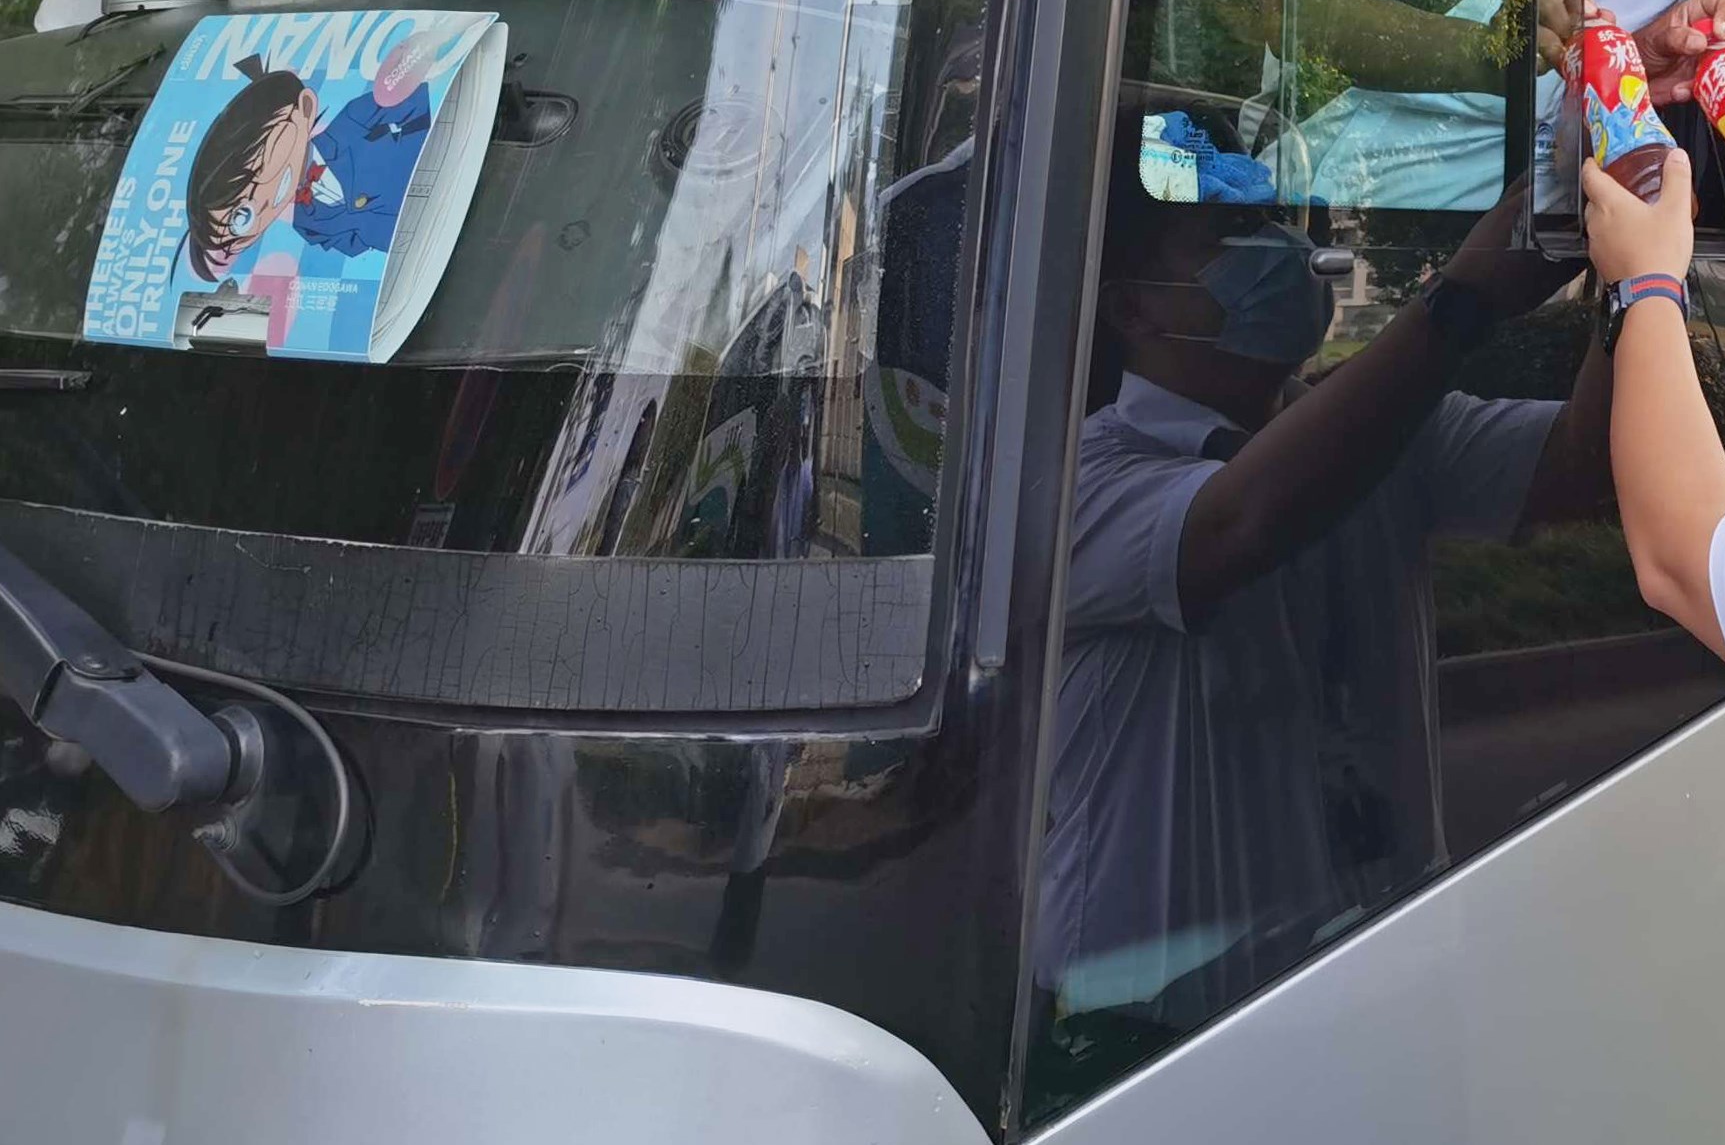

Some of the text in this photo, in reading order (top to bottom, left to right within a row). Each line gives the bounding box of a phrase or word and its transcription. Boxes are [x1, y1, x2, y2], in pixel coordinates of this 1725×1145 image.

[86, 176, 137, 335] THERE IS
[102, 229, 135, 335] ALWAYS
[115, 216, 158, 337] ONLY
[147, 119, 198, 212] ONE
[138, 199, 187, 338] TRUTH
